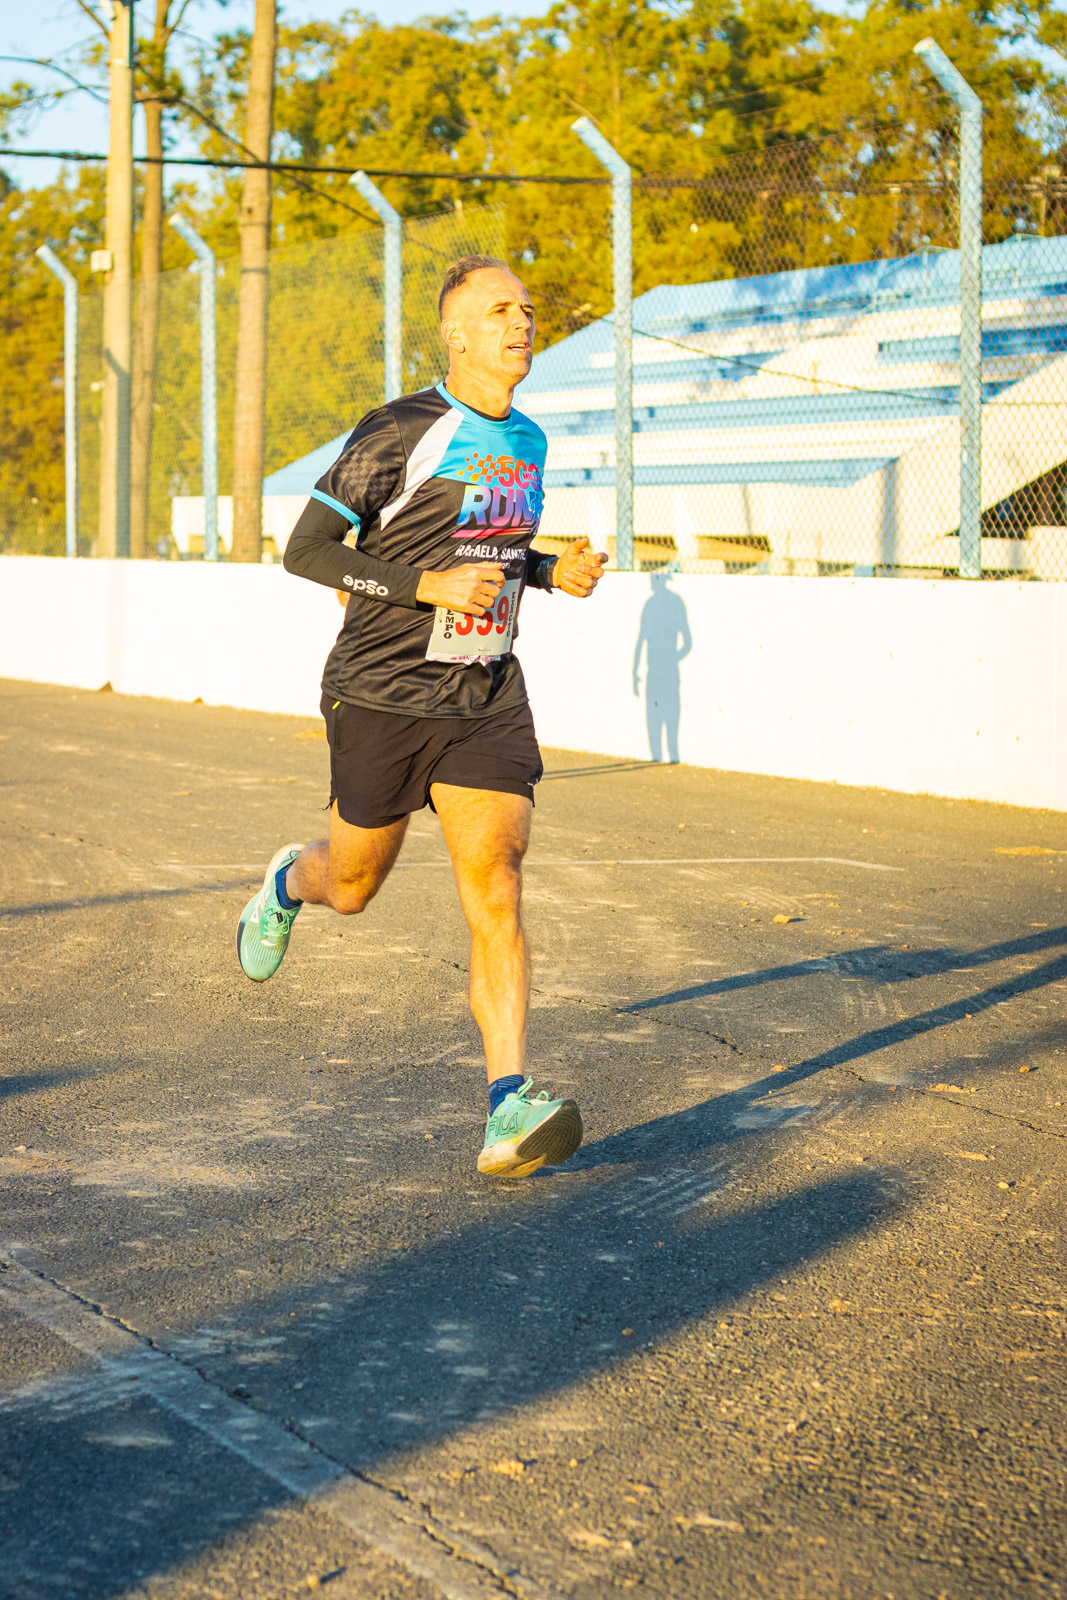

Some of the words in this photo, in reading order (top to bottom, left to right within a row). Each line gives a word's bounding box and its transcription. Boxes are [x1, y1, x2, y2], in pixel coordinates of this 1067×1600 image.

[456, 484, 538, 527] RUN
[443, 609, 455, 639] EMPO
[455, 595, 510, 636] 359
[486, 1112, 519, 1140] FILA
